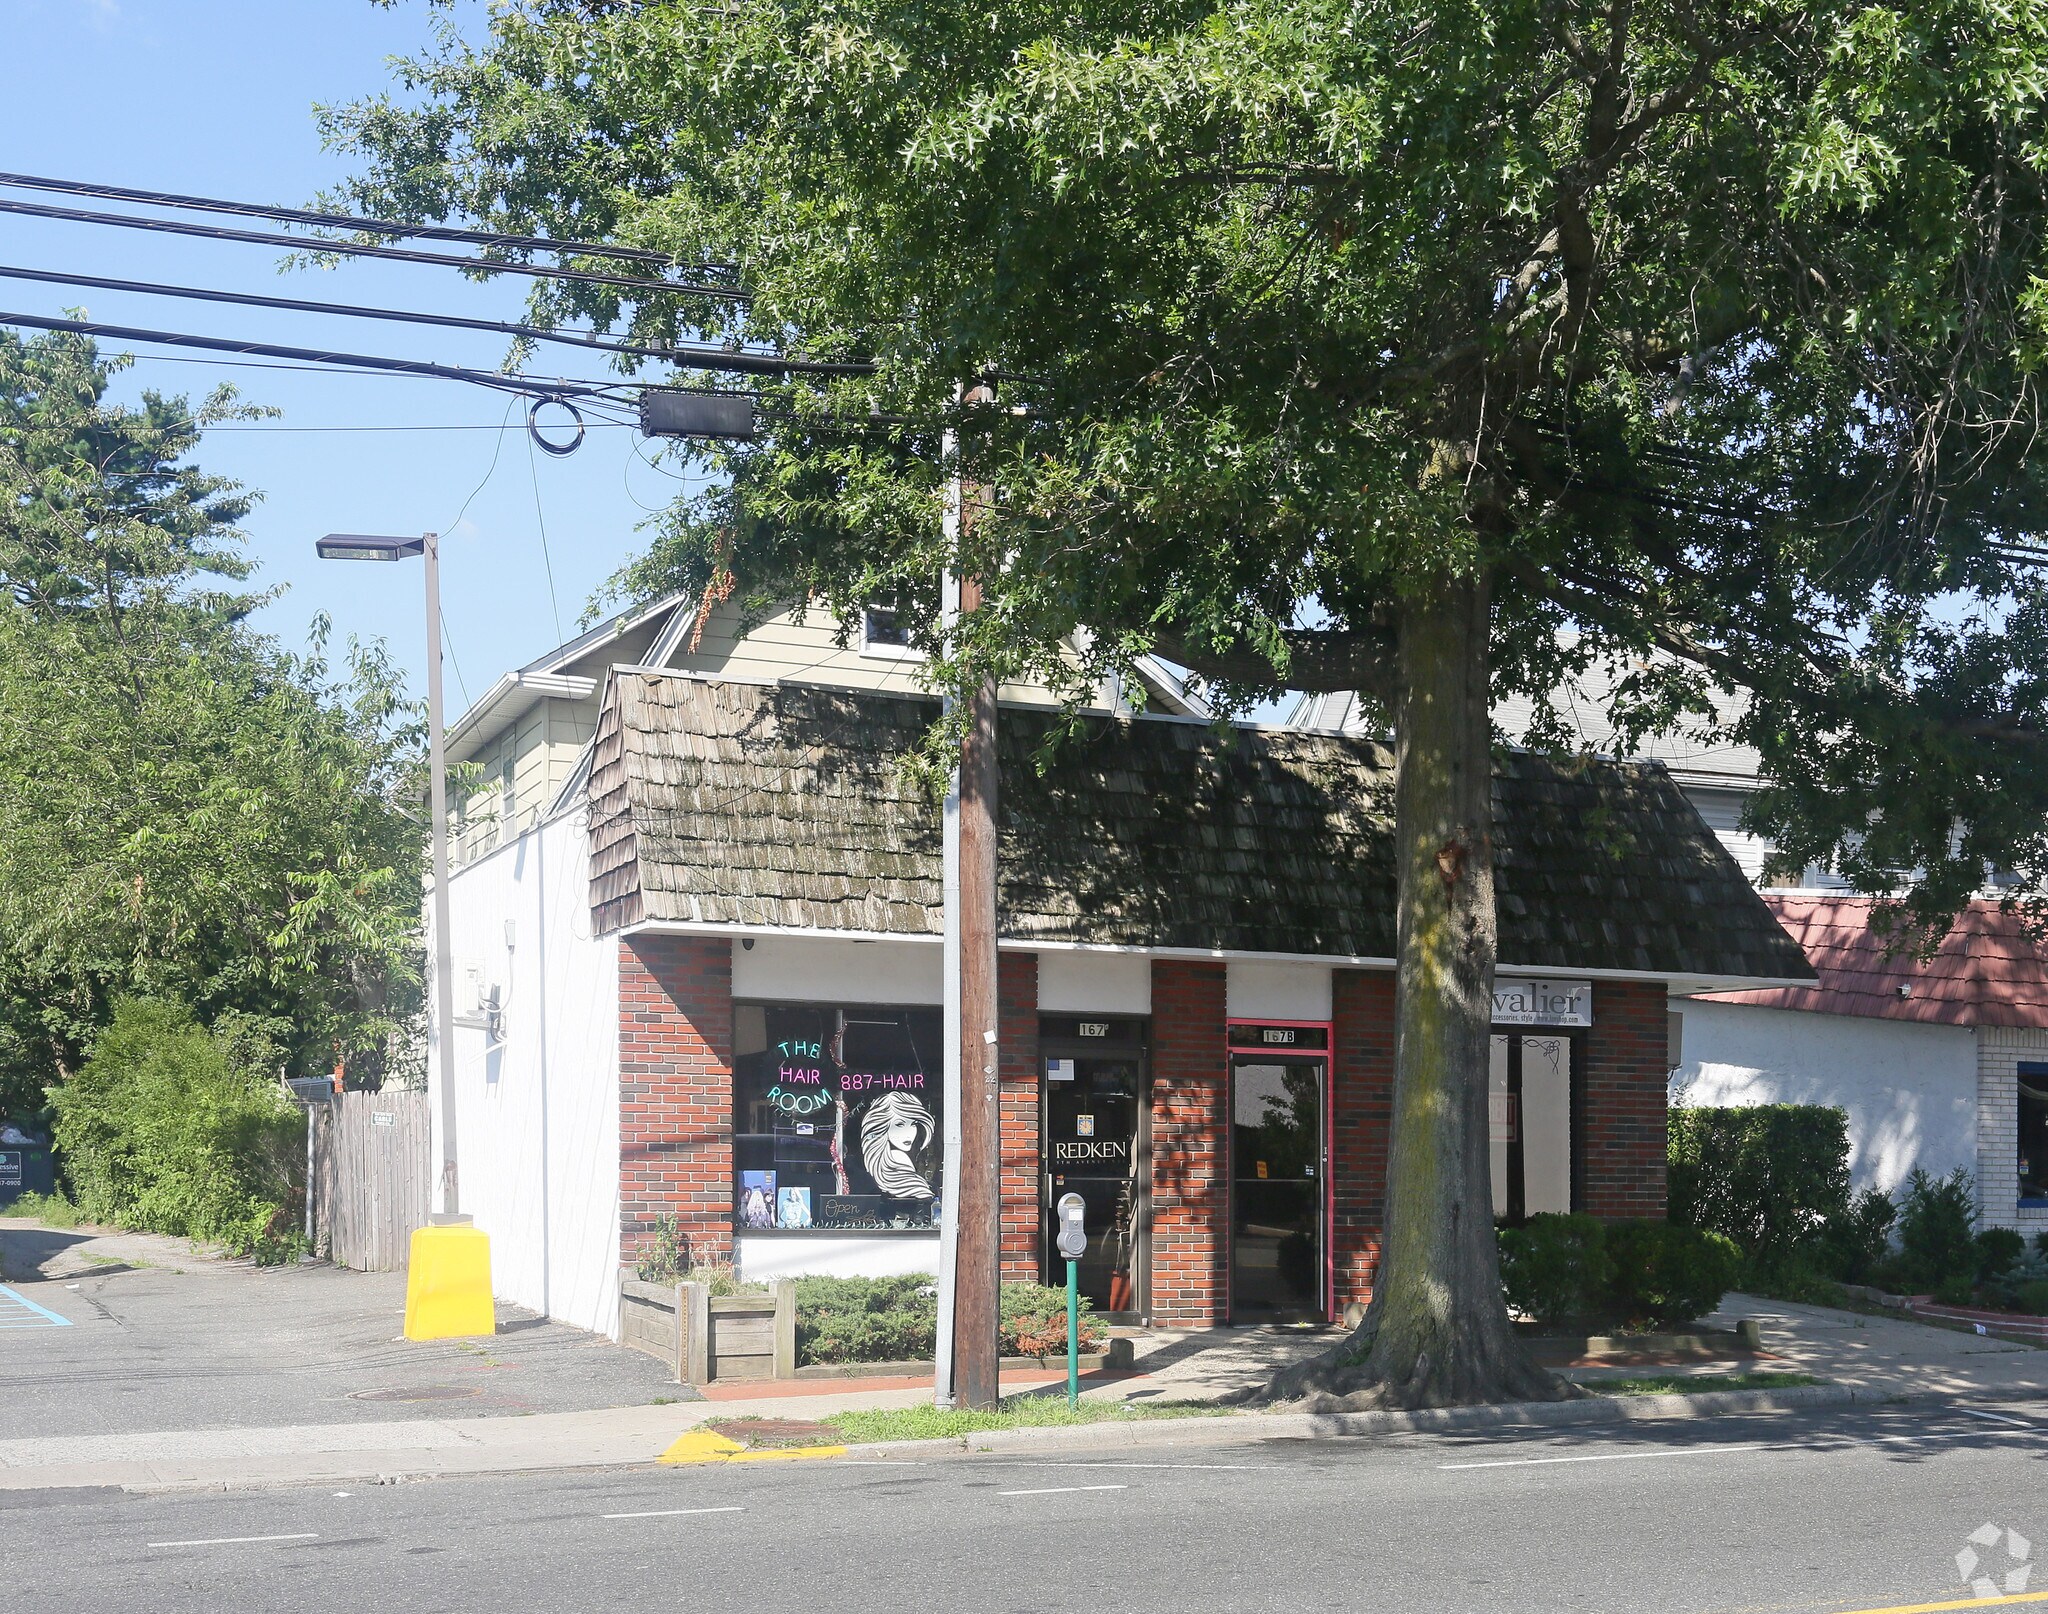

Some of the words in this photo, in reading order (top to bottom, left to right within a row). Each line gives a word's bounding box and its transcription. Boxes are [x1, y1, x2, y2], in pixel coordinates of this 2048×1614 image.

[1082, 1024, 1104, 1036] 167
[1265, 1031, 1294, 1042] 167B
[778, 1040, 821, 1059] THE
[780, 1067, 820, 1085] HAIR
[840, 1074, 925, 1091] 887-HAIR
[767, 1086, 833, 1114] ROOM
[1056, 1142, 1126, 1159] REDKEN
[825, 1199, 861, 1218] Open
